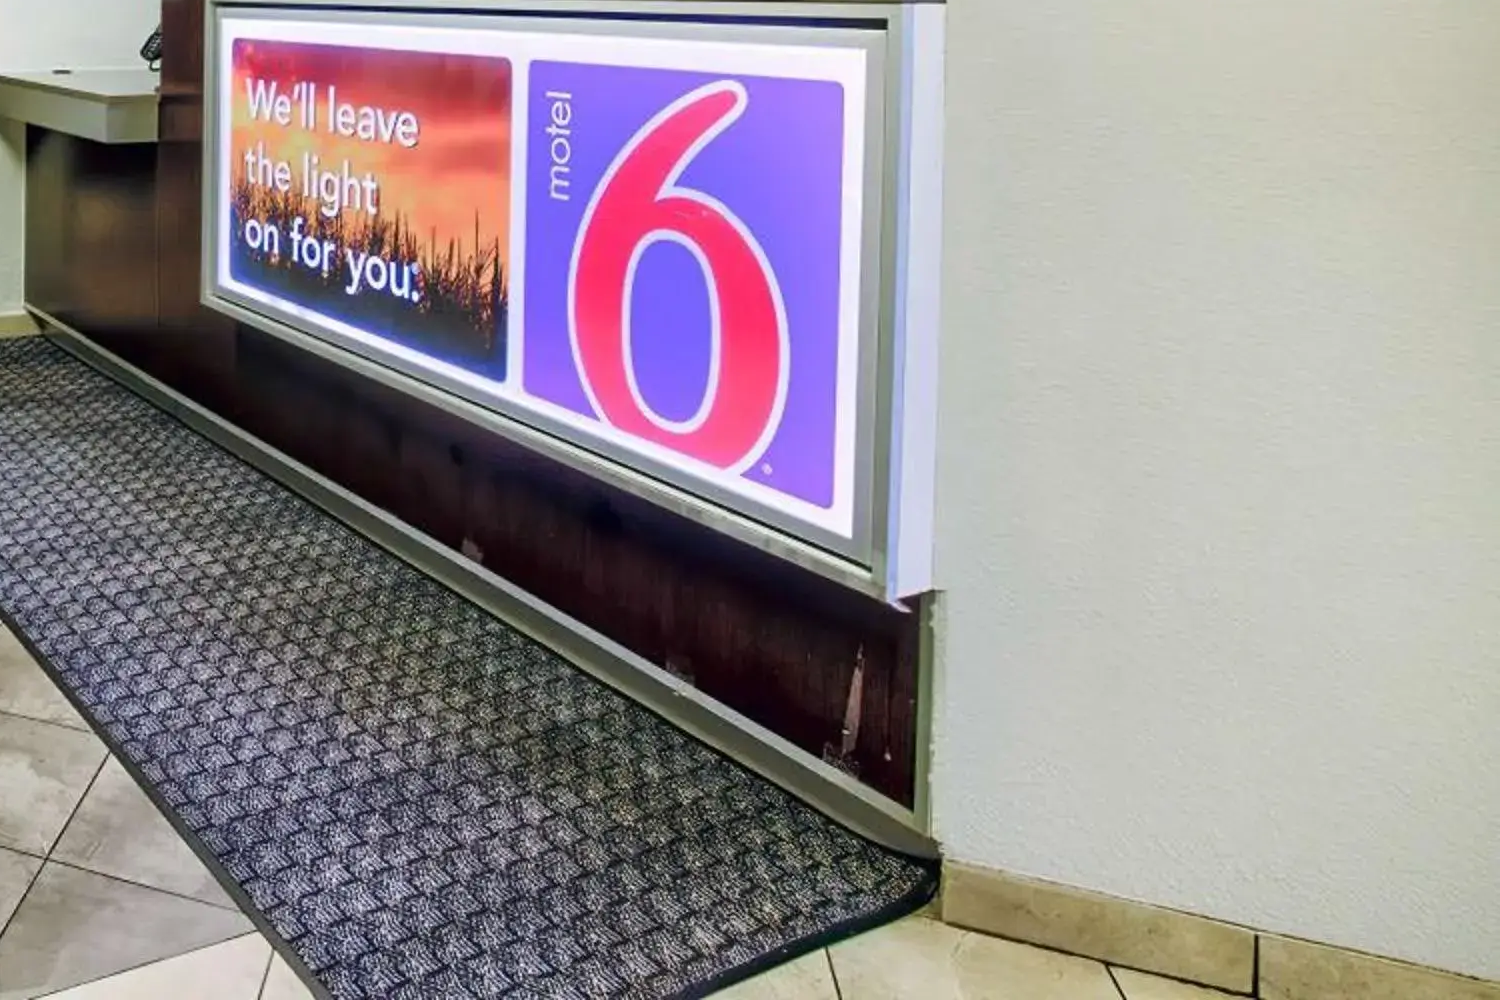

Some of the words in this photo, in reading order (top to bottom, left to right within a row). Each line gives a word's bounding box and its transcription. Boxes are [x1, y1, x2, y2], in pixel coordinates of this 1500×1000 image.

[244, 78, 316, 132] We'll
[328, 85, 420, 147] leave
[546, 90, 573, 201] motel
[244, 141, 292, 192] the
[303, 151, 378, 218] light
[245, 218, 279, 255] on
[290, 216, 336, 272] for
[567, 79, 791, 476] 6
